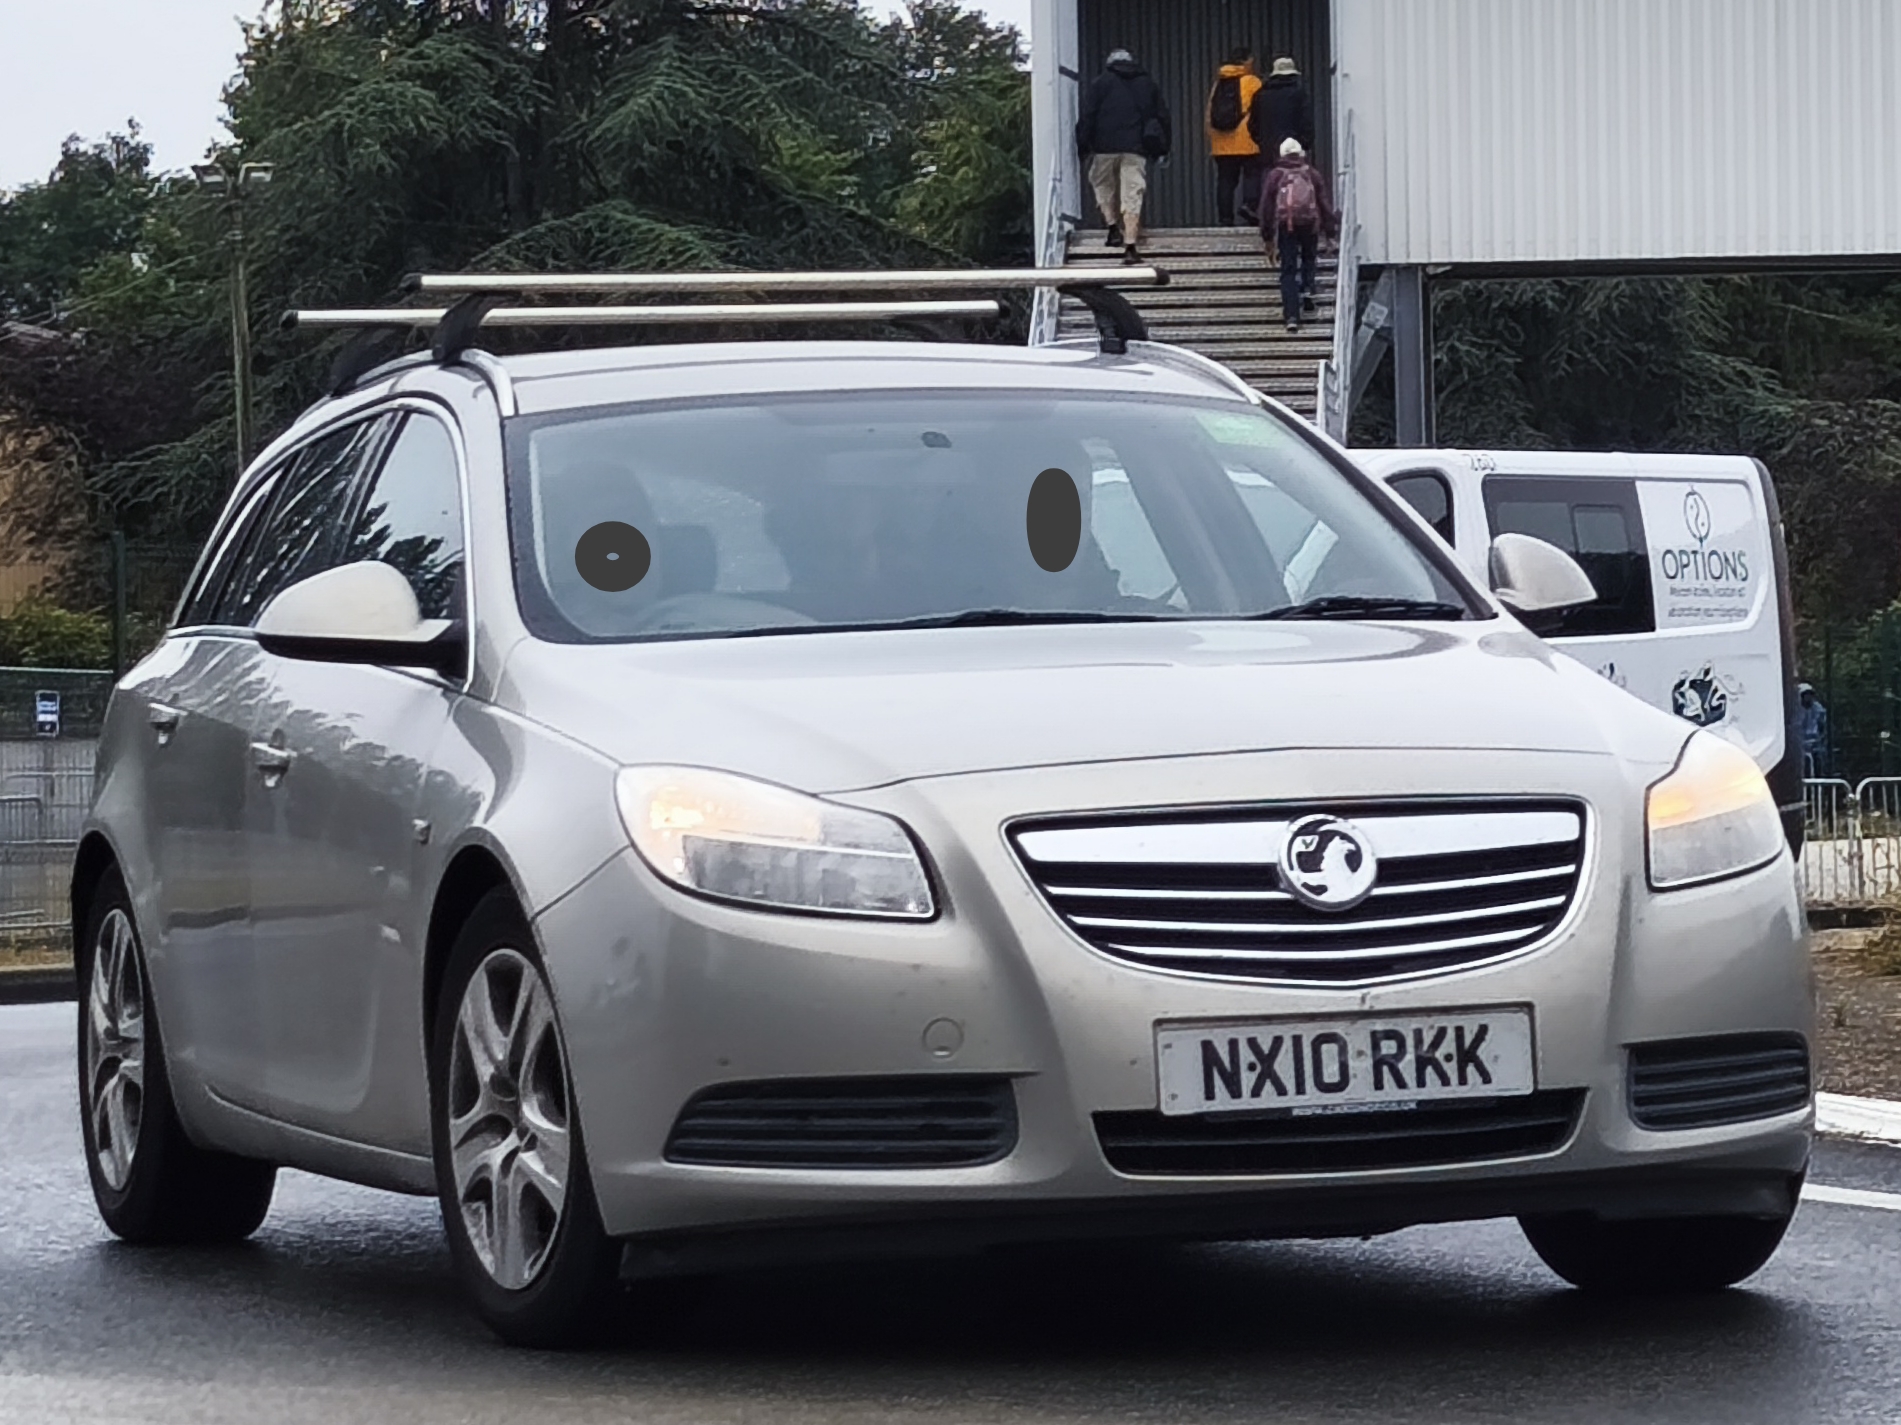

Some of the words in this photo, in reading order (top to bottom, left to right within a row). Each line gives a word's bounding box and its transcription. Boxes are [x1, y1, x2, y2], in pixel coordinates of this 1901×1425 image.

[1662, 549, 1749, 582] OPTIONS
[1201, 1031, 1349, 1101] NX10
[1370, 1023, 1492, 1091] RKK
